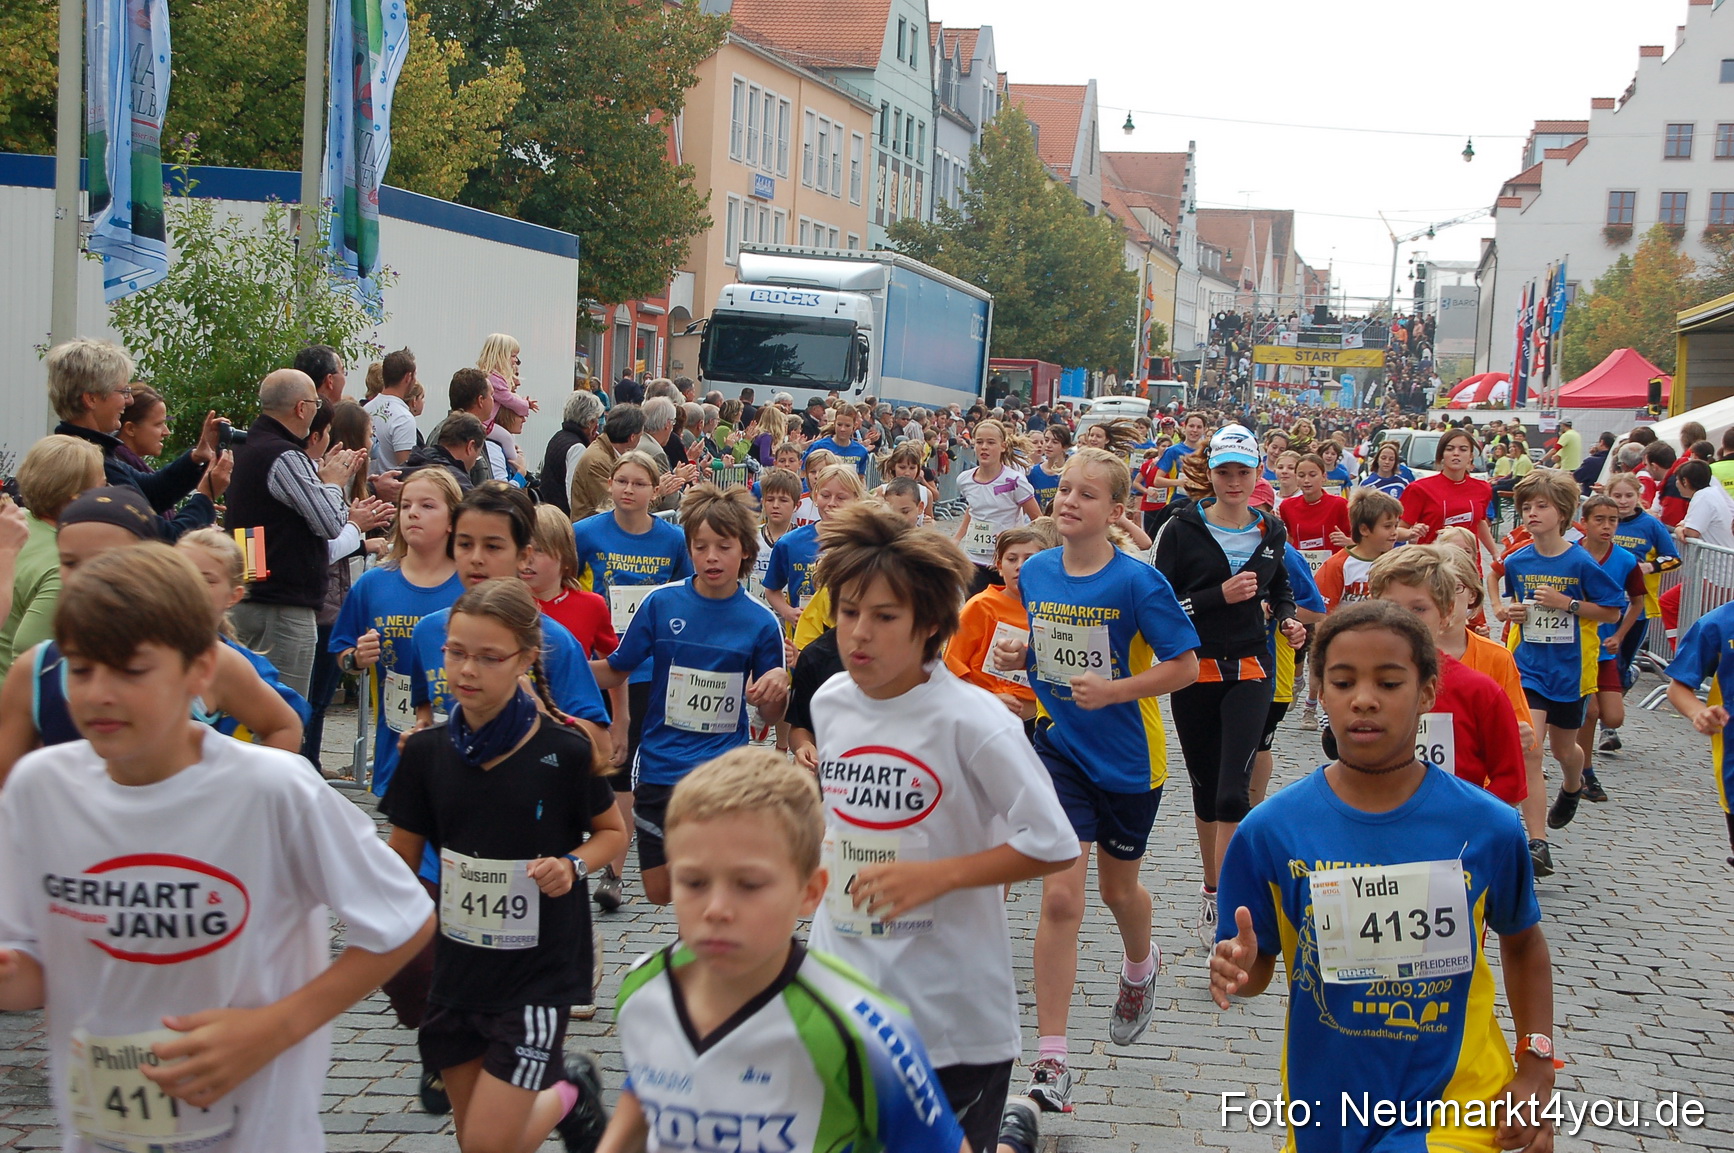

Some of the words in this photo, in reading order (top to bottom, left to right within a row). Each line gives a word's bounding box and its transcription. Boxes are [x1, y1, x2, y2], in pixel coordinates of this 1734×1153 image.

[750, 289, 821, 307] BOCK
[1295, 351, 1340, 362] START
[1237, 445, 1254, 453] TEAM
[596, 552, 607, 561] 10.
[608, 552, 671, 567] NEUMARKTER
[793, 563, 805, 571] 10.
[606, 561, 659, 575] STADTLAUF
[1525, 575, 1579, 585] NEUMARKTER
[1028, 601, 1037, 612] 10.
[1039, 601, 1120, 620] NEUMARKTER
[1535, 616, 1569, 629] 4124
[1051, 627, 1074, 642] Jana
[1054, 647, 1104, 668] 4033
[690, 673, 728, 689] Thomas
[687, 693, 736, 713] 4078
[910, 776, 922, 788] &
[841, 839, 897, 863] Thomas
[1116, 844, 1135, 852] JAKO
[461, 862, 508, 884] Susann
[43, 873, 200, 909] GERHART
[206, 890, 222, 905] &
[1352, 875, 1399, 898] Yada
[461, 891, 529, 920] 4149
[1322, 914, 1331, 931] J
[1359, 906, 1456, 944] 4135
[1414, 955, 1469, 970] PFLEIDERER
[1365, 978, 1453, 999] 20.09.2009
[515, 1045, 551, 1062] adidas
